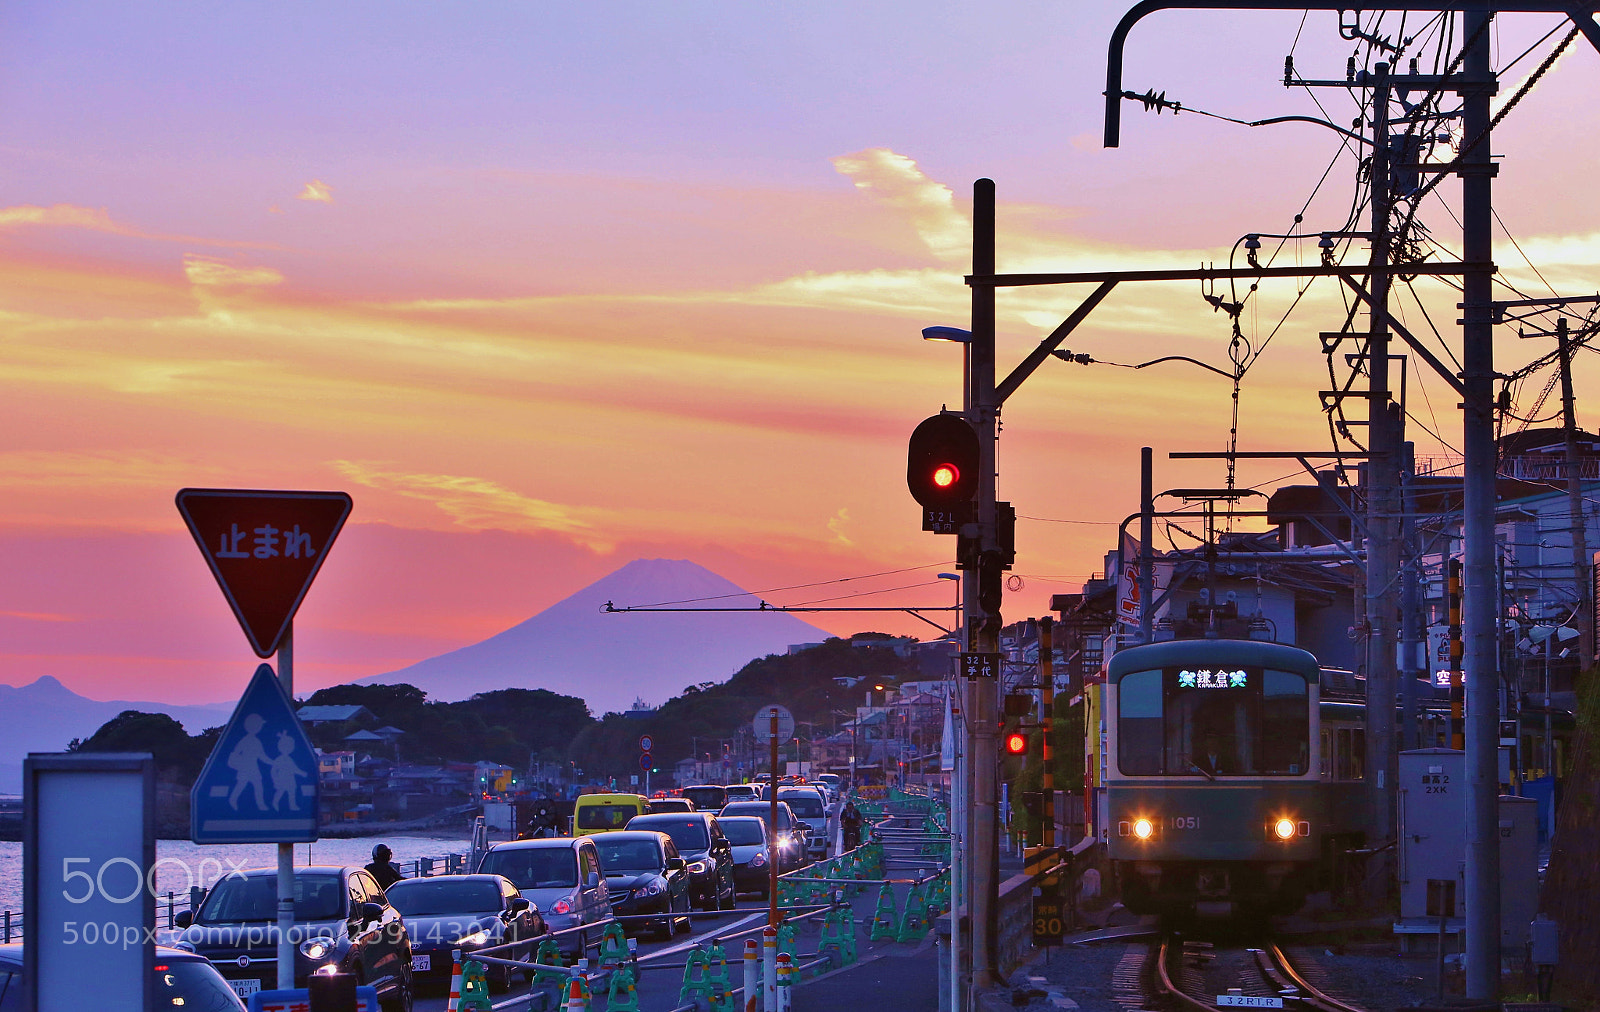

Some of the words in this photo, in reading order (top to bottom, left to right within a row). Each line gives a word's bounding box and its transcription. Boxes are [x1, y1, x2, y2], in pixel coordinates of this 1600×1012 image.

[215, 522, 317, 560] 止まれ
[967, 665, 992, 677] 手代
[1196, 669, 1229, 684] 鎌倉
[642, 739, 651, 748] 50
[1426, 786, 1447, 794] 2XK
[1171, 816, 1200, 830] 1051
[1035, 918, 1062, 935] 30
